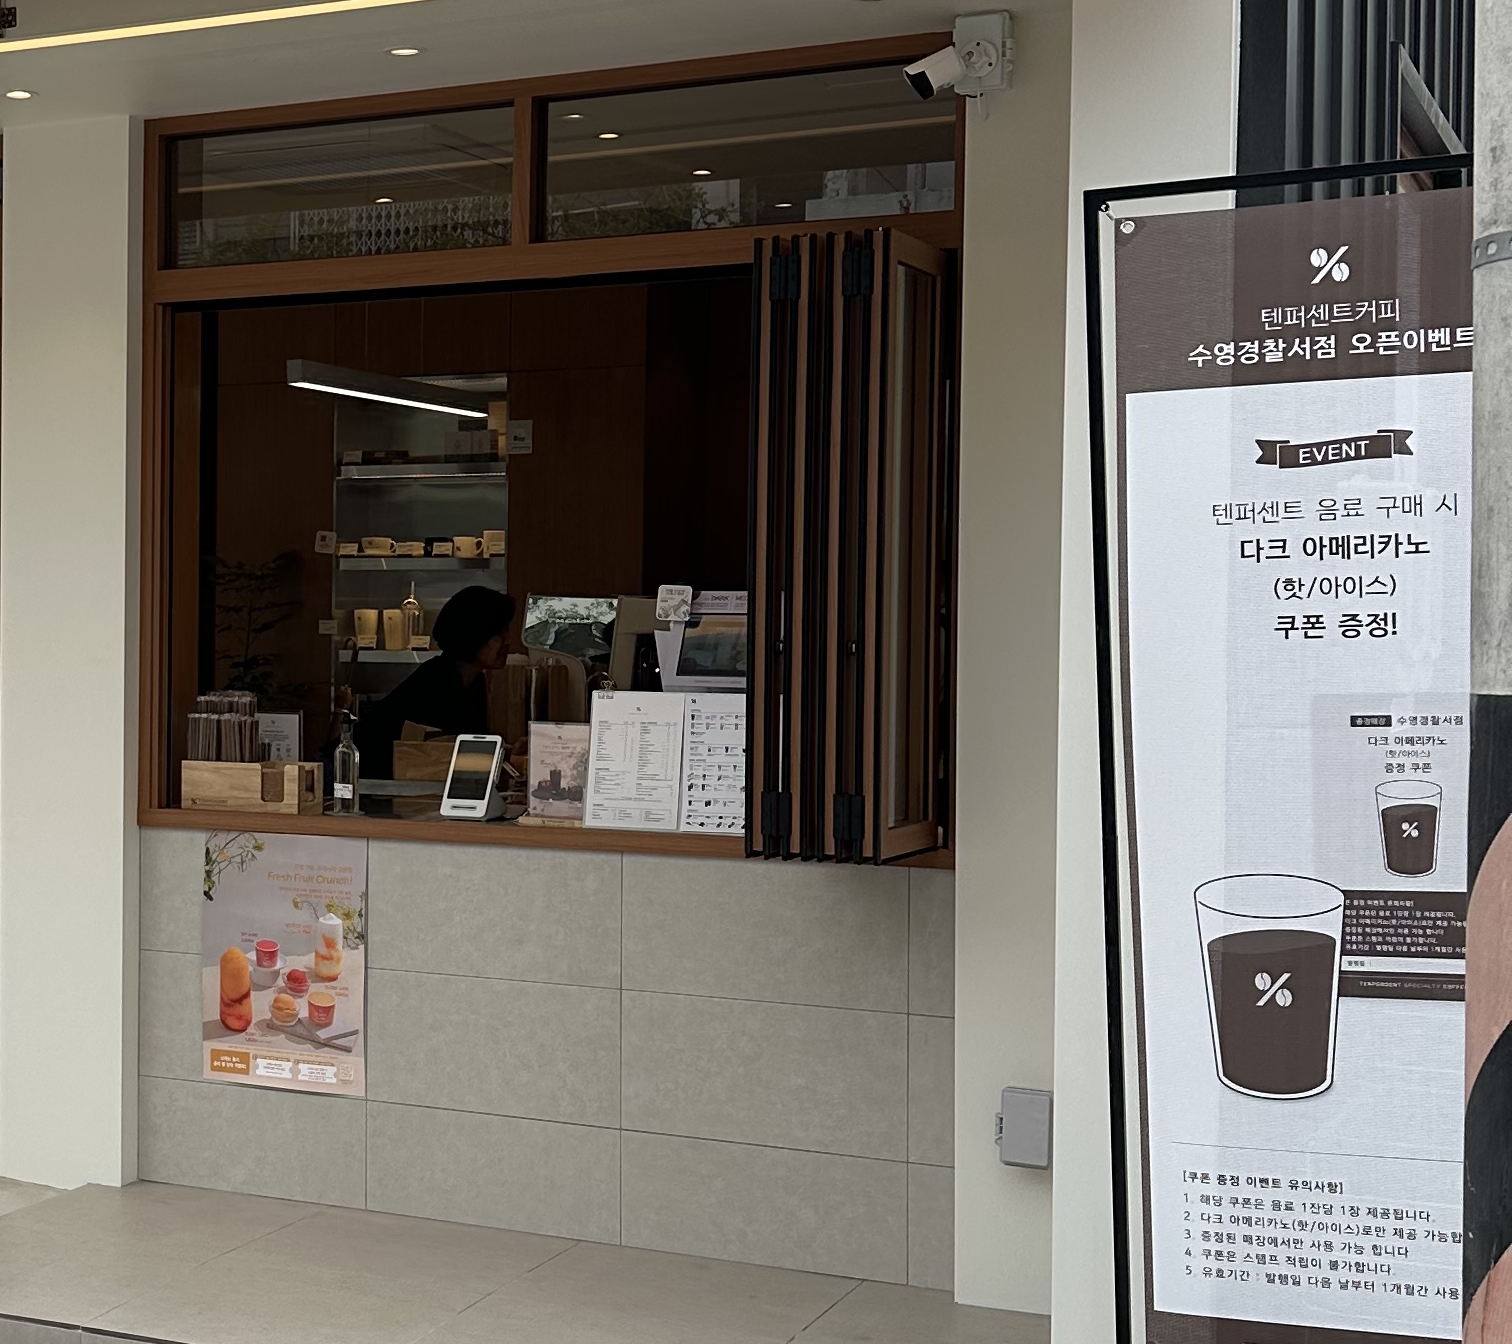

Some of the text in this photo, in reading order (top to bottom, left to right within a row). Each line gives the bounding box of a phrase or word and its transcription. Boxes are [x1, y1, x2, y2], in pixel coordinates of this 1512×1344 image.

[1260, 299, 1401, 331] 텐퍼센트커피
[1187, 326, 1474, 367] 수영경찰서점 오픈이벤트
[1299, 440, 1370, 464] EVENT
[1211, 492, 1460, 526] 텐퍼센트 음료 구매 시
[1240, 533, 1431, 563] 다크 아메리카노
[1273, 574, 1397, 601] (핫/아이스)
[1274, 611, 1398, 640] 쿠폰 증정!
[1368, 736, 1389, 747] 다크
[1246, 1176, 1283, 1189] 이벤트
[1288, 1179, 1343, 1195] 유의사항]
[1200, 1194, 1223, 1207] 해당
[1229, 1196, 1265, 1210] 쿠폰은
[1301, 1202, 1333, 1216] 1잔당
[1340, 1205, 1360, 1217] 1장
[1200, 1212, 1223, 1224] 다크
[1392, 1227, 1417, 1241] 제공
[1243, 1234, 1304, 1250] 매장에서만
[1310, 1239, 1334, 1252] 사용
[1340, 1242, 1365, 1255] 가능
[1285, 1256, 1322, 1269] 적립이
[1202, 1267, 1250, 1281] 유효기간
[1265, 1271, 1301, 1286] 발행일
[1308, 1276, 1332, 1289] 다음
[1338, 1278, 1375, 1293] 날부터
[1382, 1282, 1428, 1297] 1개월간
